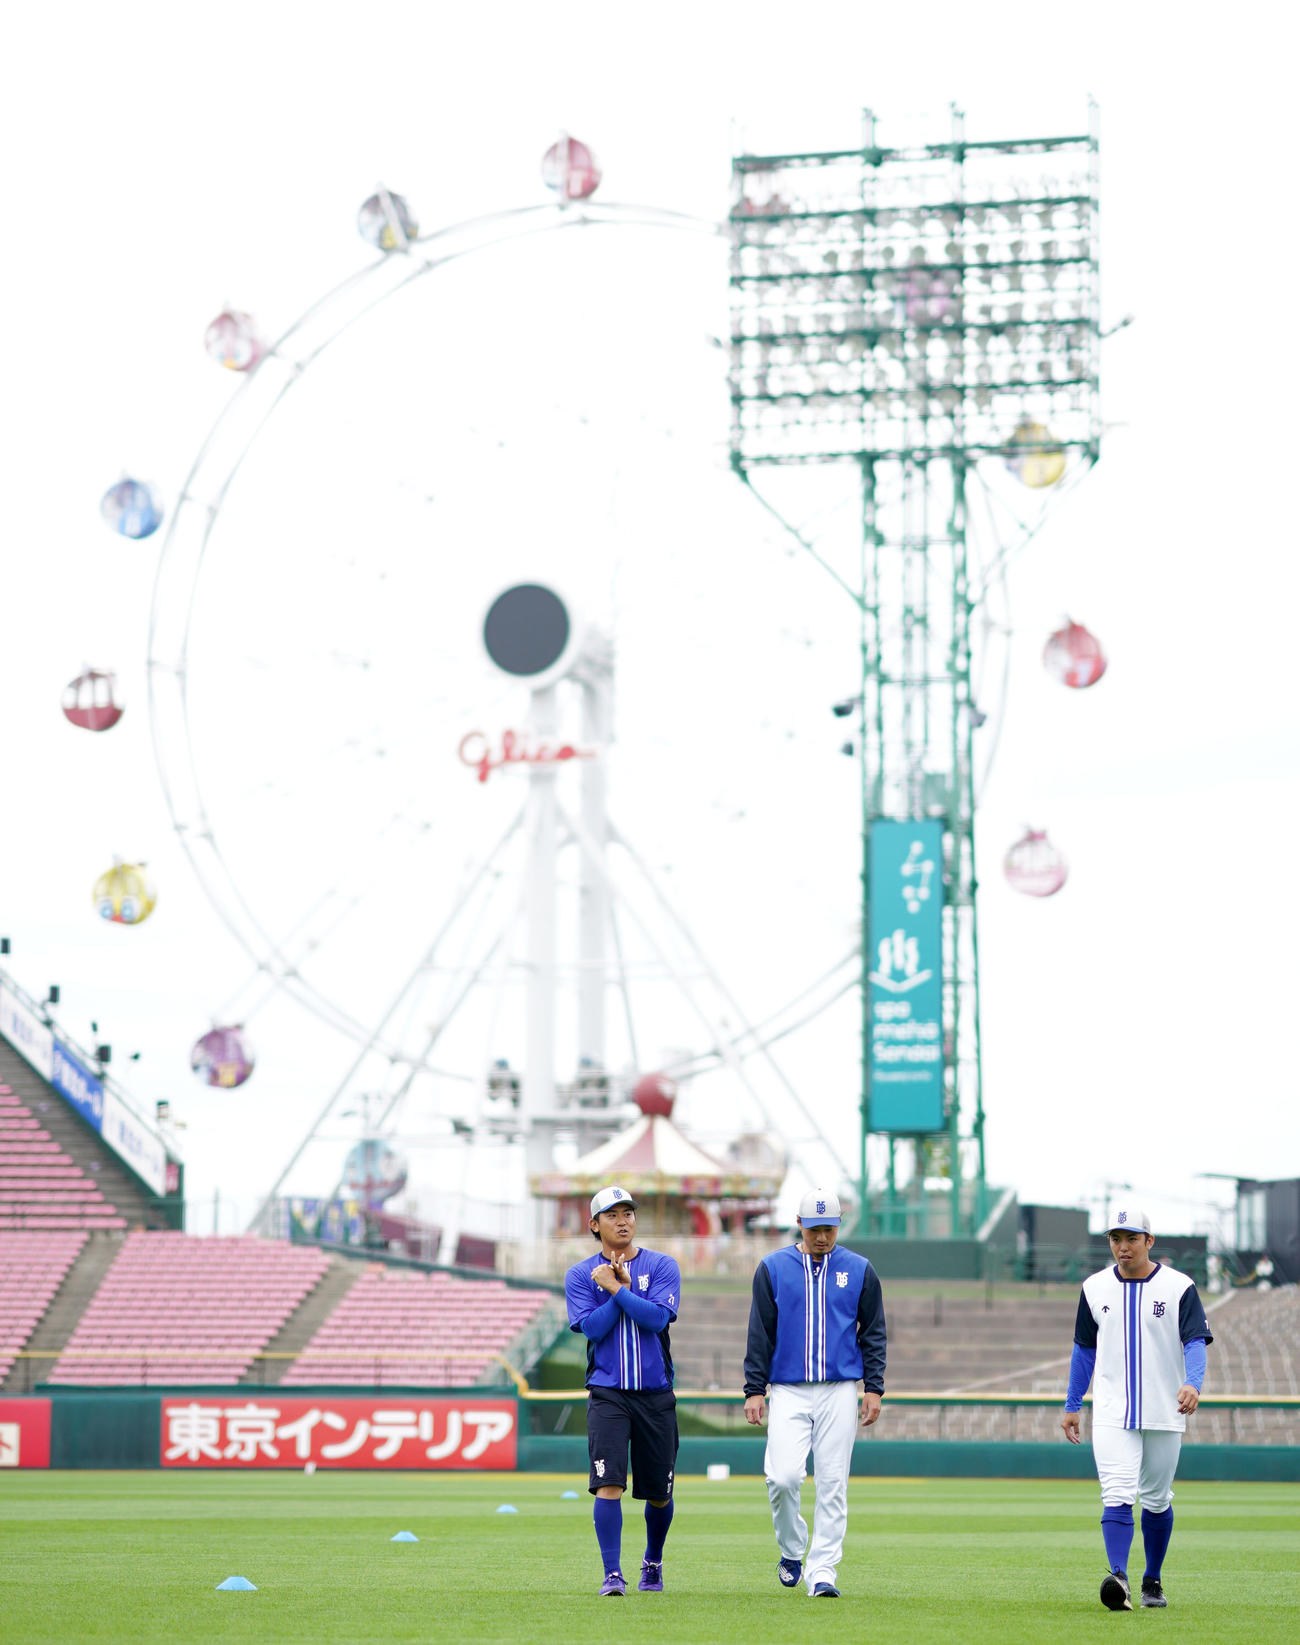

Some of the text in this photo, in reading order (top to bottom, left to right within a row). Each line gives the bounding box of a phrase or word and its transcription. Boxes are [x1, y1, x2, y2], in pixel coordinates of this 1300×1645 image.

[165, 1403, 514, 1461] 東京インテリア
